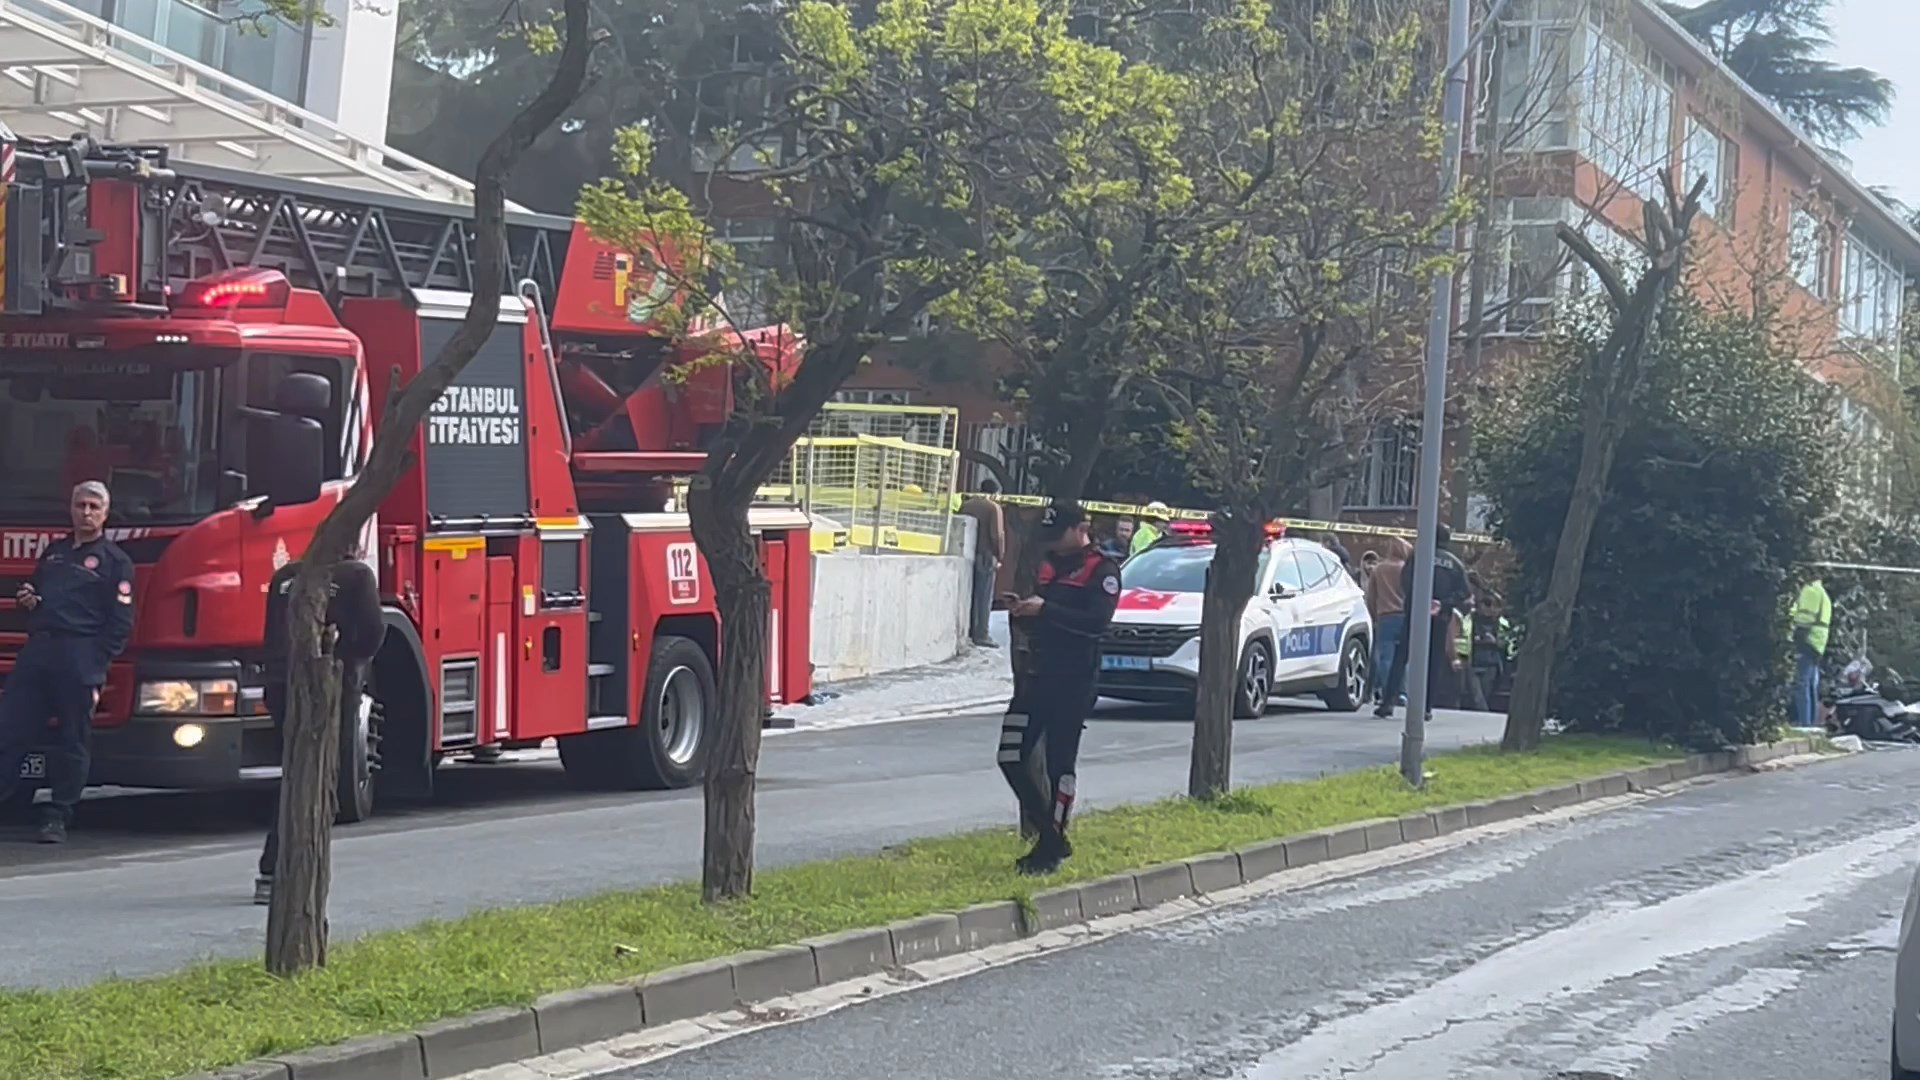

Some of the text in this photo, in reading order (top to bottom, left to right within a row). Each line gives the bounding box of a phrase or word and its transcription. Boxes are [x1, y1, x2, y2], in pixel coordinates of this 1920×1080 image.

[430, 386, 519, 413] STANBUL
[430, 416, 519, 444] İTFAİYESİ
[671, 548, 693, 577] 112
[1285, 628, 1311, 654] POLİS
